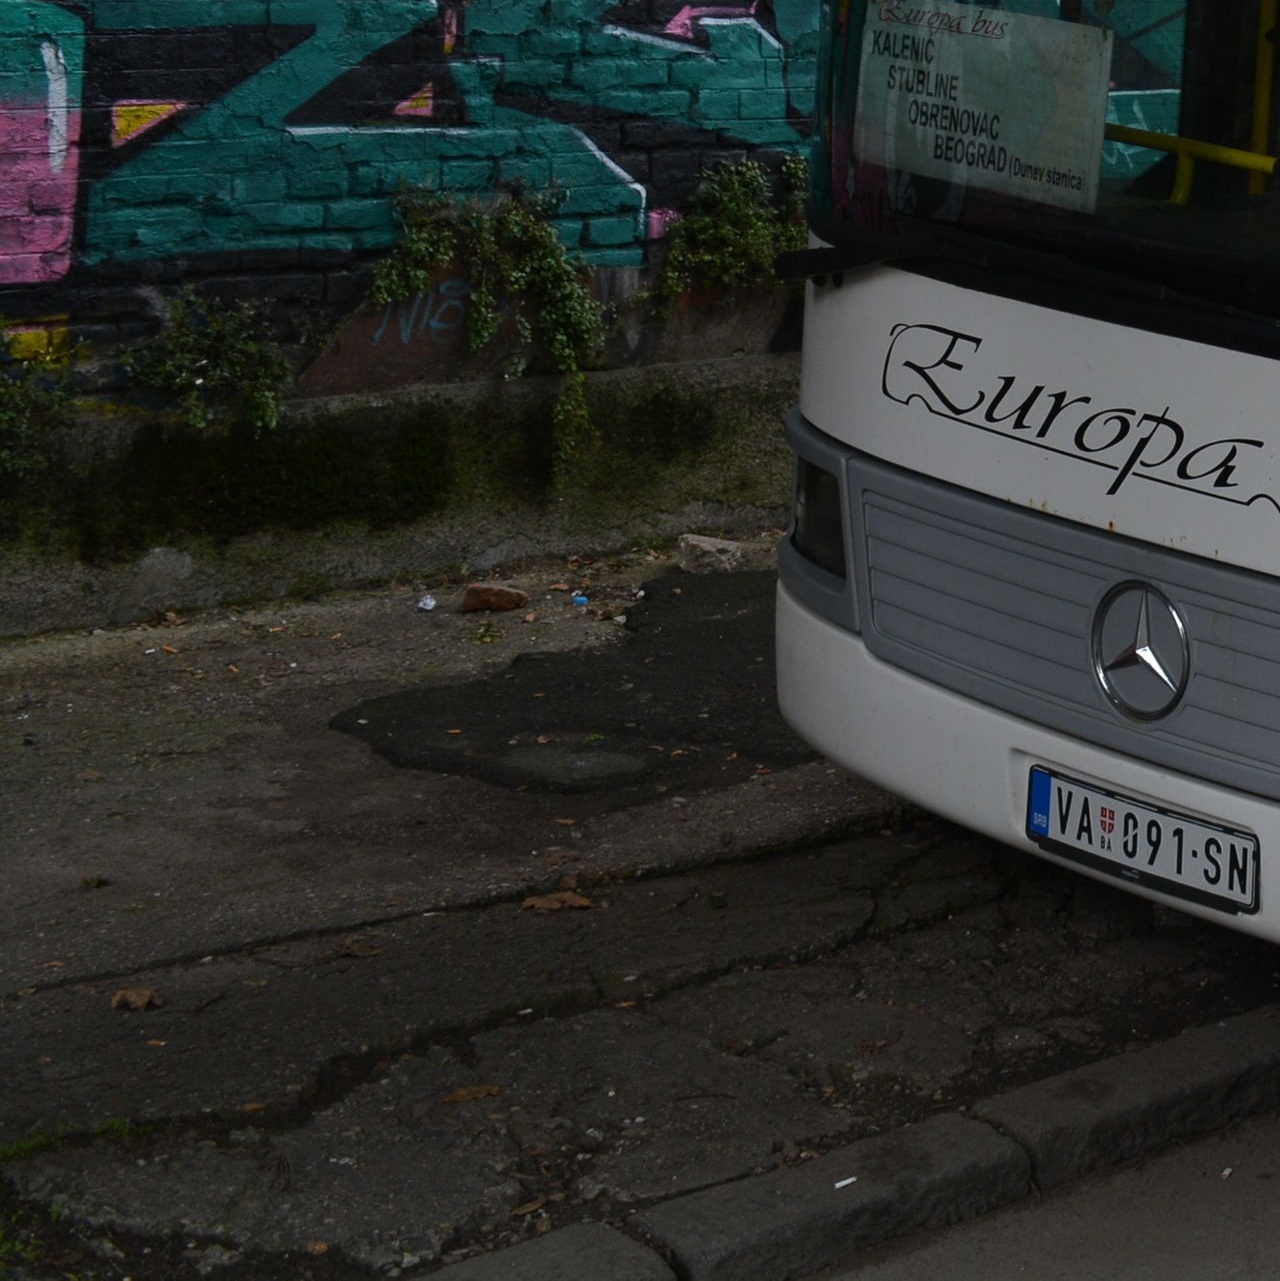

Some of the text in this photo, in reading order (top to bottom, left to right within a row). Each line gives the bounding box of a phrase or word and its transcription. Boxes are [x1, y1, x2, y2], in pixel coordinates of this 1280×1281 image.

[880, 0, 1009, 36] Europa bus
[871, 30, 935, 64] KALENIĆ
[887, 65, 959, 100] STUBLINE
[908, 100, 1000, 140] OBRENOVAC
[934, 134, 1086, 194] BEOGRAD (Dunav stanica)
[882, 323, 1264, 495] Europa
[1057, 786, 1094, 845] VA
